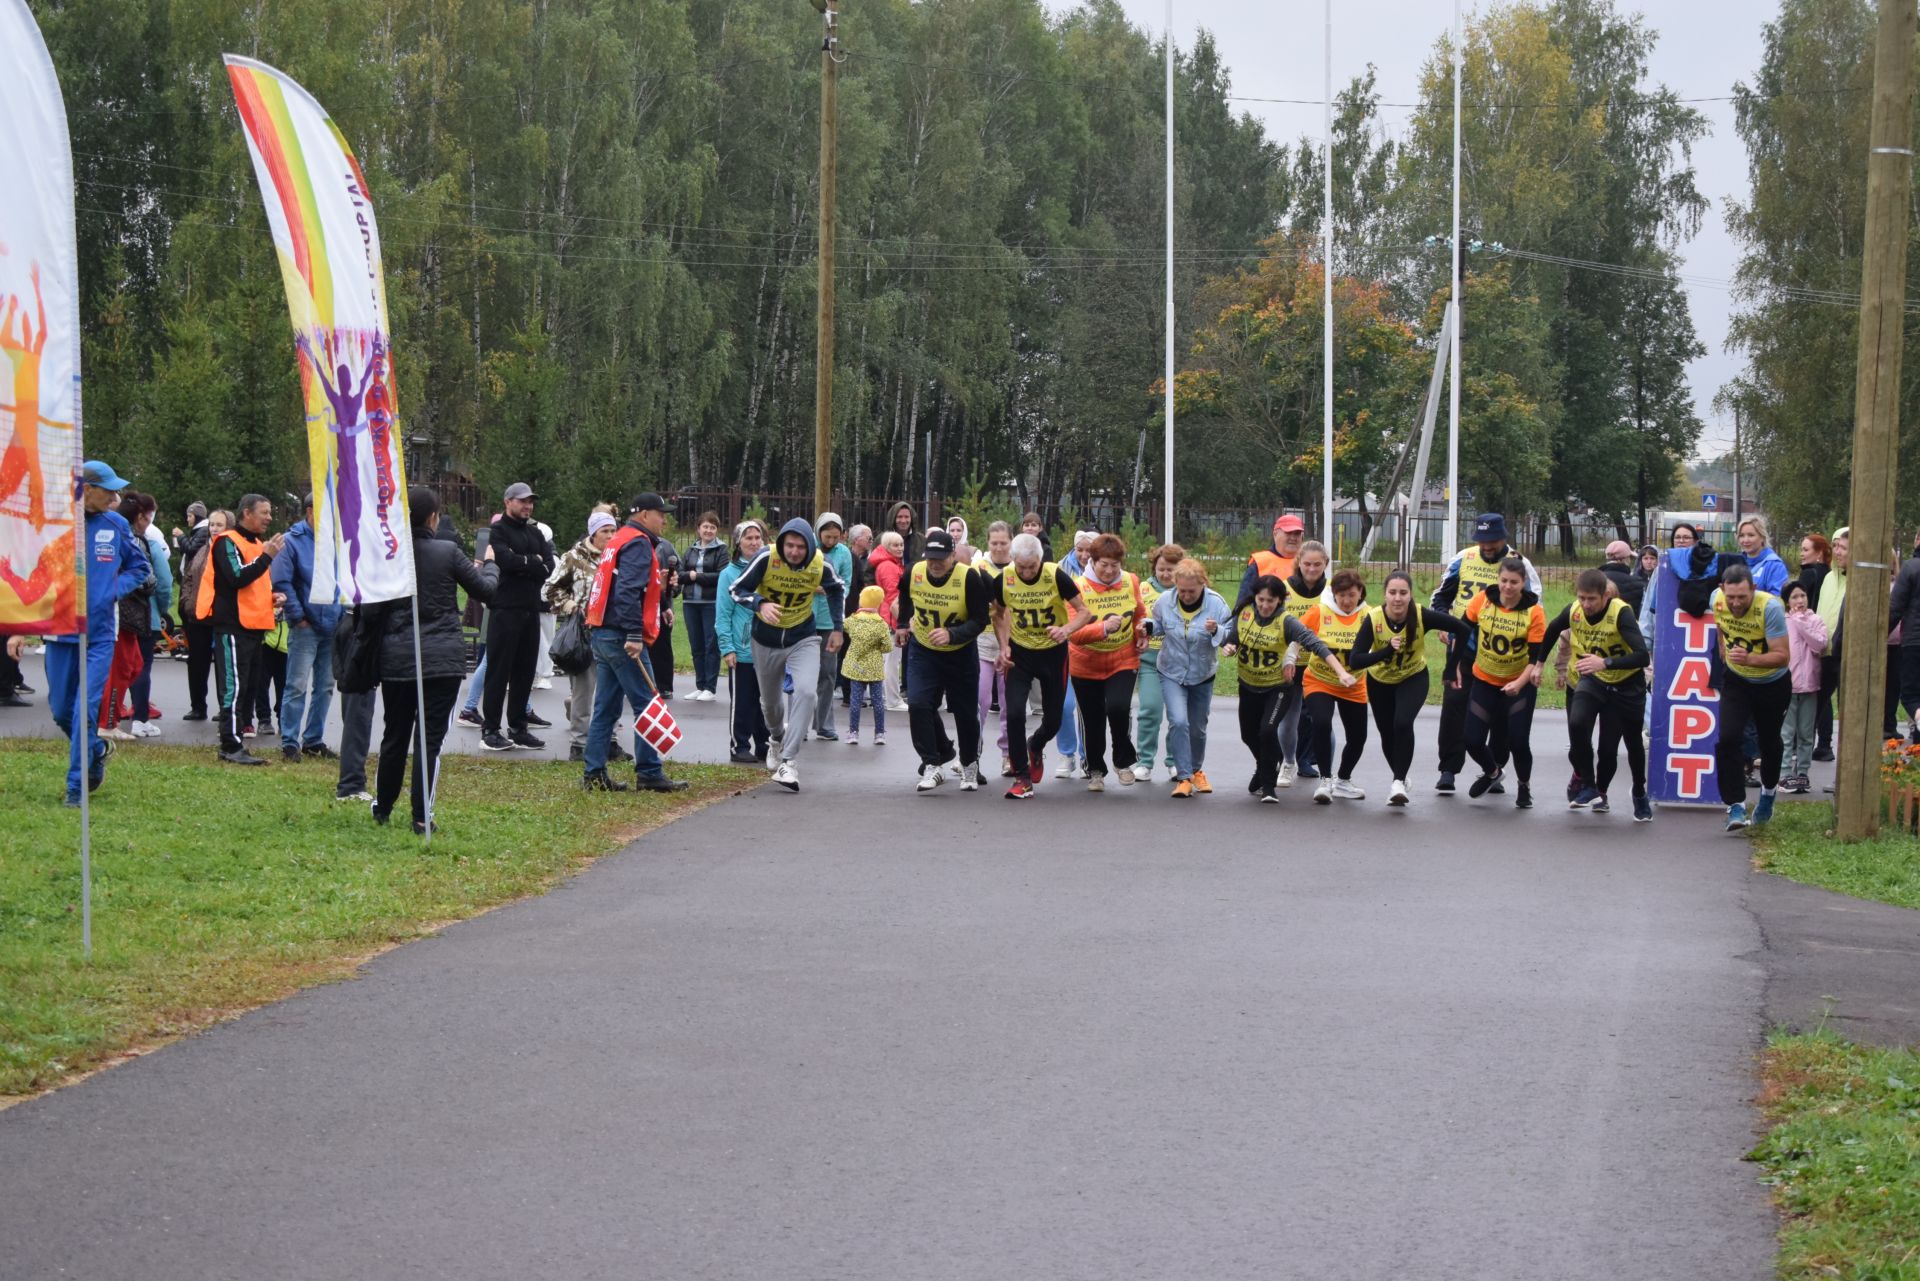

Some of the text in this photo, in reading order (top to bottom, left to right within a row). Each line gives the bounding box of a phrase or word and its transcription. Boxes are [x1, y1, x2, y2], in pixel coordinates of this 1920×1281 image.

[1474, 573, 1498, 581] РАЙОН
[767, 586, 811, 609] 315
[916, 590, 959, 601] ТУКАЕВСКИЙ
[1010, 590, 1053, 599] ТУКАЕВСКИЙ
[1088, 593, 1130, 605] ТУКАЕВСКИЙ
[925, 599, 949, 608] РАЙОН
[1020, 597, 1044, 605] РАЙОН
[1097, 602, 1122, 610] РАЙОН
[1013, 605, 1056, 629] 313
[1484, 614, 1526, 628] ТУКАЕВСКИЙ
[1720, 616, 1760, 630] ТУКАЕВСКИЙ
[1492, 622, 1515, 633] РАЙОН
[1728, 625, 1752, 634] РАЙОН
[1241, 627, 1280, 642] ТУКАЕВСКИЙ
[1481, 629, 1526, 655] 309
[1238, 643, 1279, 668] 318
[1666, 608, 1720, 799] ТАРТ
